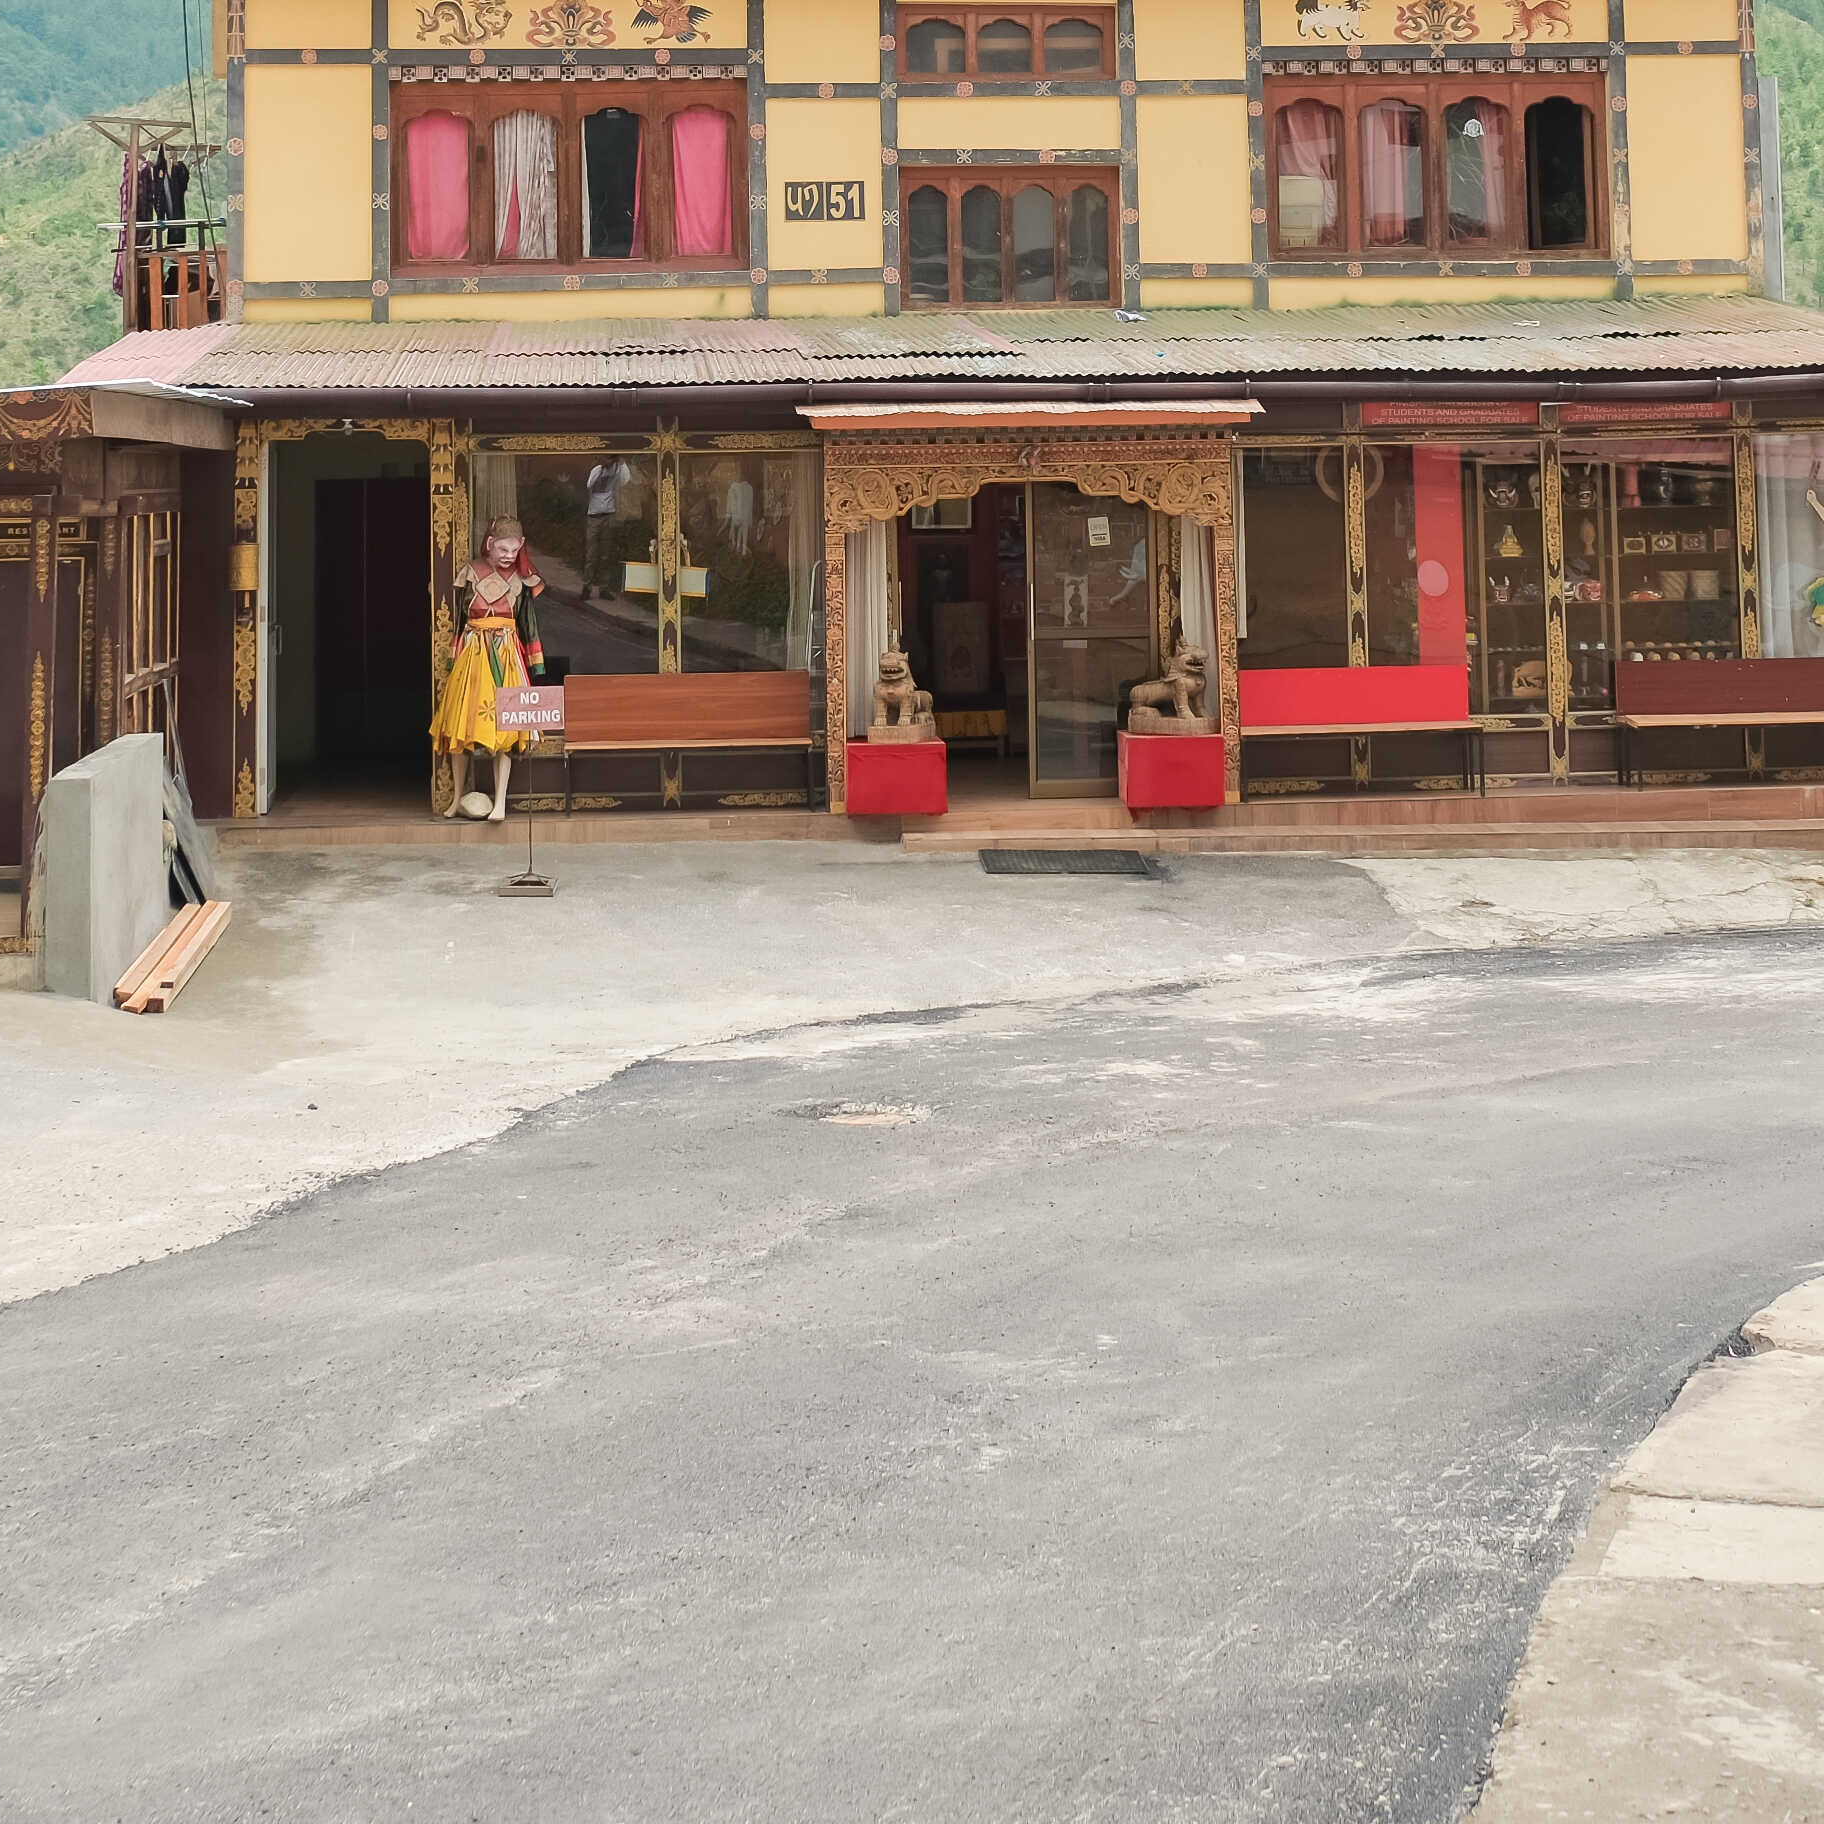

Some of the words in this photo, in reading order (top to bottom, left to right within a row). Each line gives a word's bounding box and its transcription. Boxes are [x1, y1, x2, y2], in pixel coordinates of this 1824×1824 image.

[829, 183, 860, 219] 51
[1381, 408, 1434, 416] STUDENTS
[1436, 408, 1458, 416] AND
[1372, 417, 1386, 425] OF
[1387, 417, 1433, 425] PAINTING
[1436, 417, 1480, 425] SCHOOL
[1480, 416, 1501, 424] FOR
[1503, 416, 1528, 424] SALE
[520, 691, 540, 705] NO
[501, 709, 561, 725] PARKING
